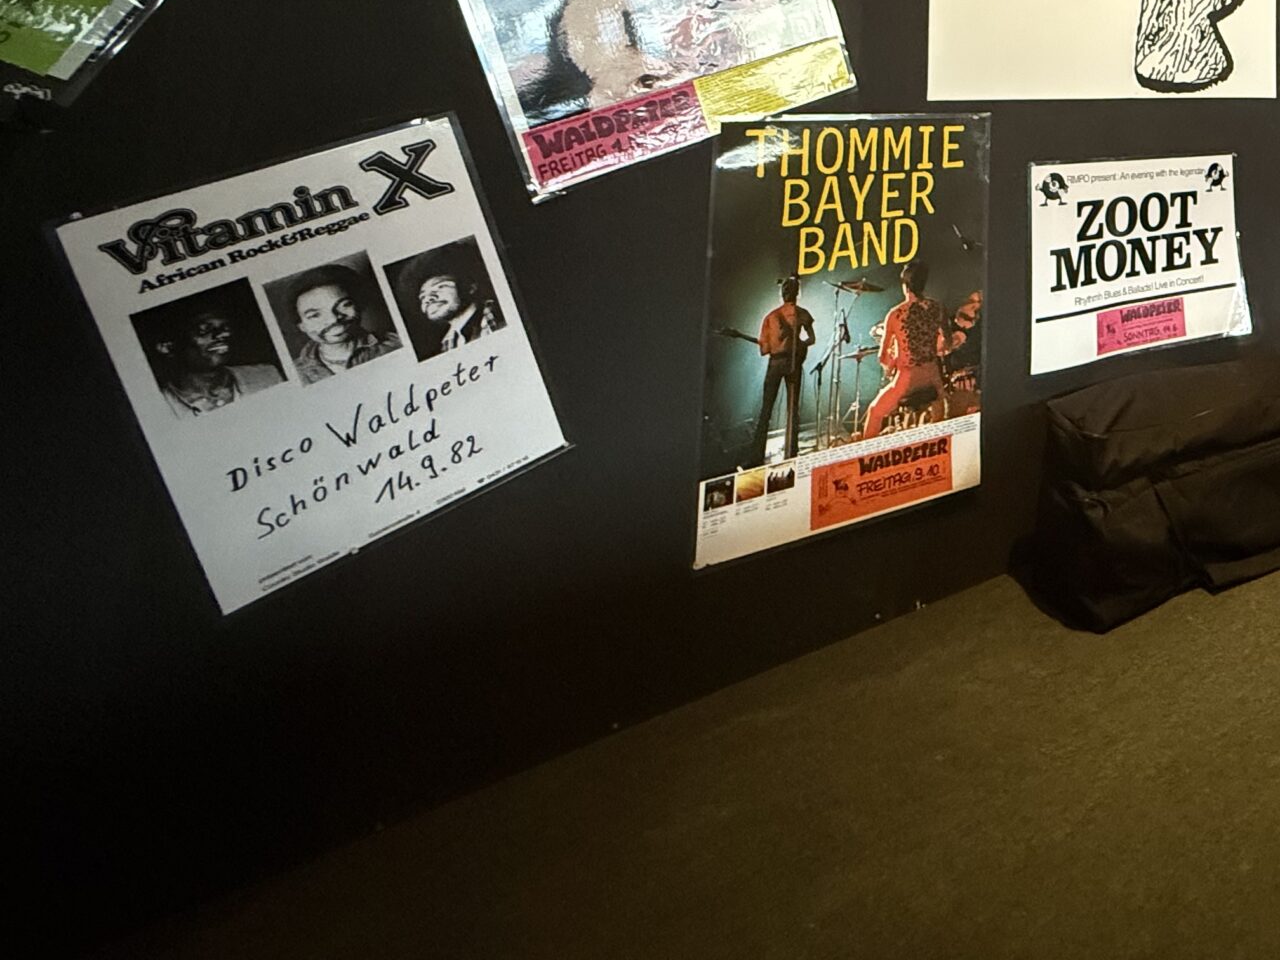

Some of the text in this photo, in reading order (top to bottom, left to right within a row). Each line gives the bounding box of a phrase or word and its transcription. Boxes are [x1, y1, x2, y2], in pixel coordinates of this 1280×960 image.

[745, 125, 965, 178] THOMMIE
[1120, 172, 1130, 180] An
[1168, 168, 1179, 176] the
[99, 139, 456, 276] Vitamin X
[782, 171, 935, 227] BAYER
[1077, 191, 1198, 242] ZOOT
[797, 218, 919, 275] BAND
[1050, 227, 1223, 292] MONEY
[138, 258, 226, 294] African
[1104, 289, 1121, 299] Blues
[1155, 280, 1168, 290] Live
[226, 353, 500, 493] Disco Waldpeter
[256, 418, 441, 540] Schönwald
[374, 434, 484, 504] 14.9.82
[858, 438, 949, 476] WALDPETER
